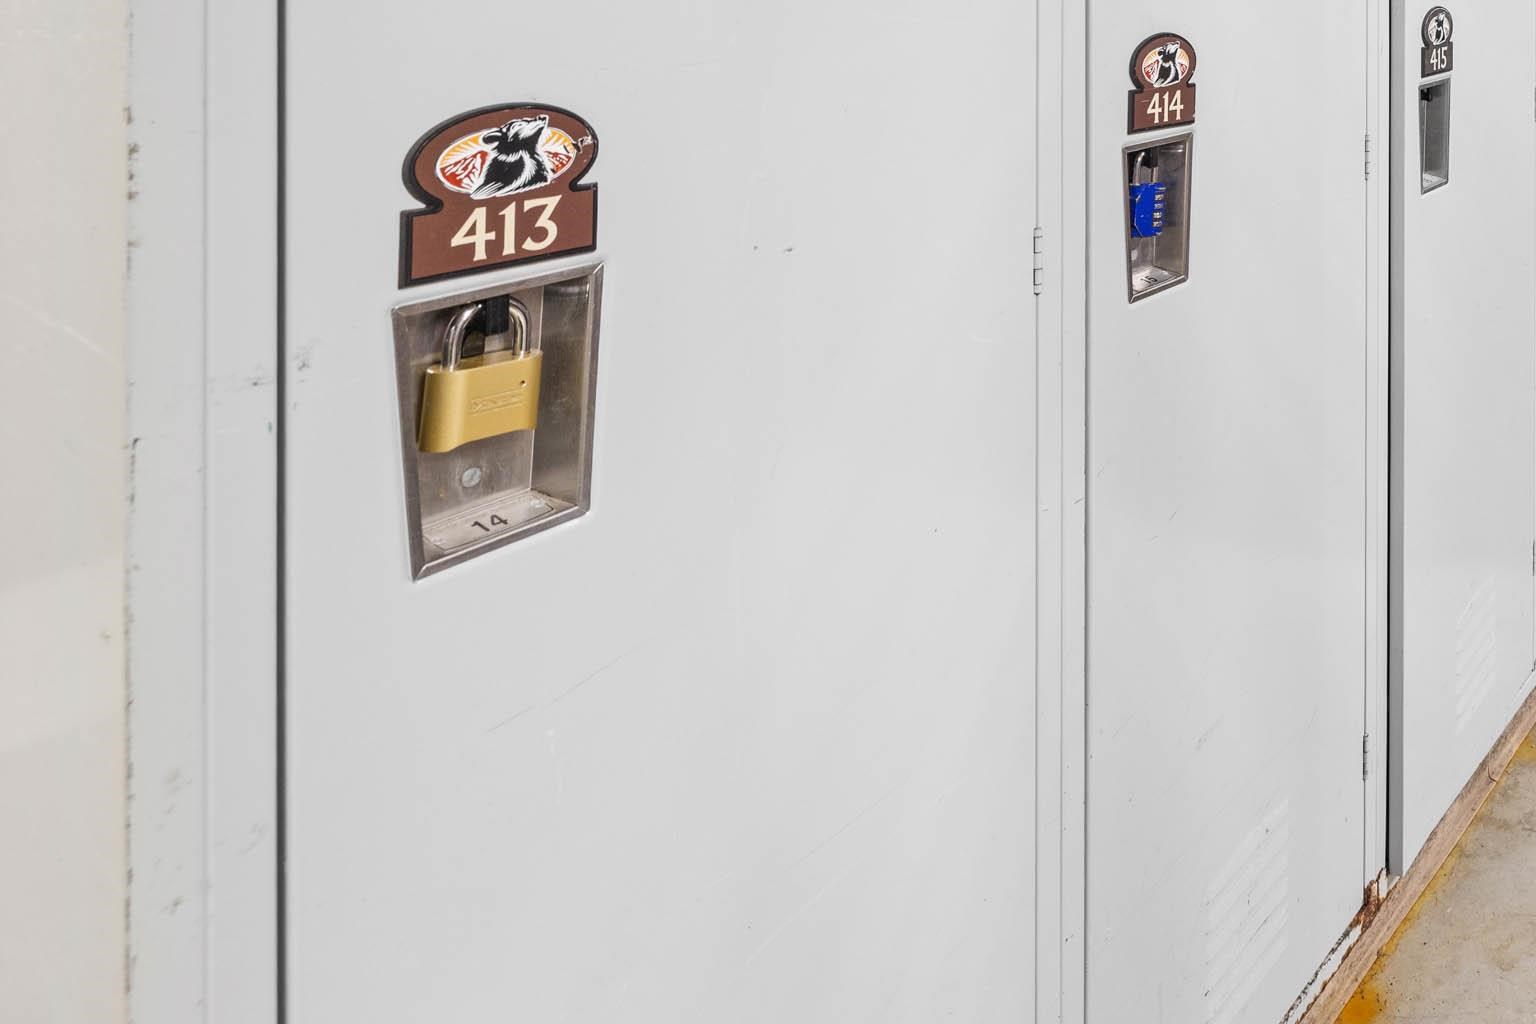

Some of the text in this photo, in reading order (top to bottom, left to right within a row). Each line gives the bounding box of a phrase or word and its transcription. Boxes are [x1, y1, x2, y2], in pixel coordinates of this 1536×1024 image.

[1429, 46, 1448, 71] 415
[1146, 89, 1184, 124] 414
[450, 194, 563, 262] 413
[471, 513, 508, 532] 14
